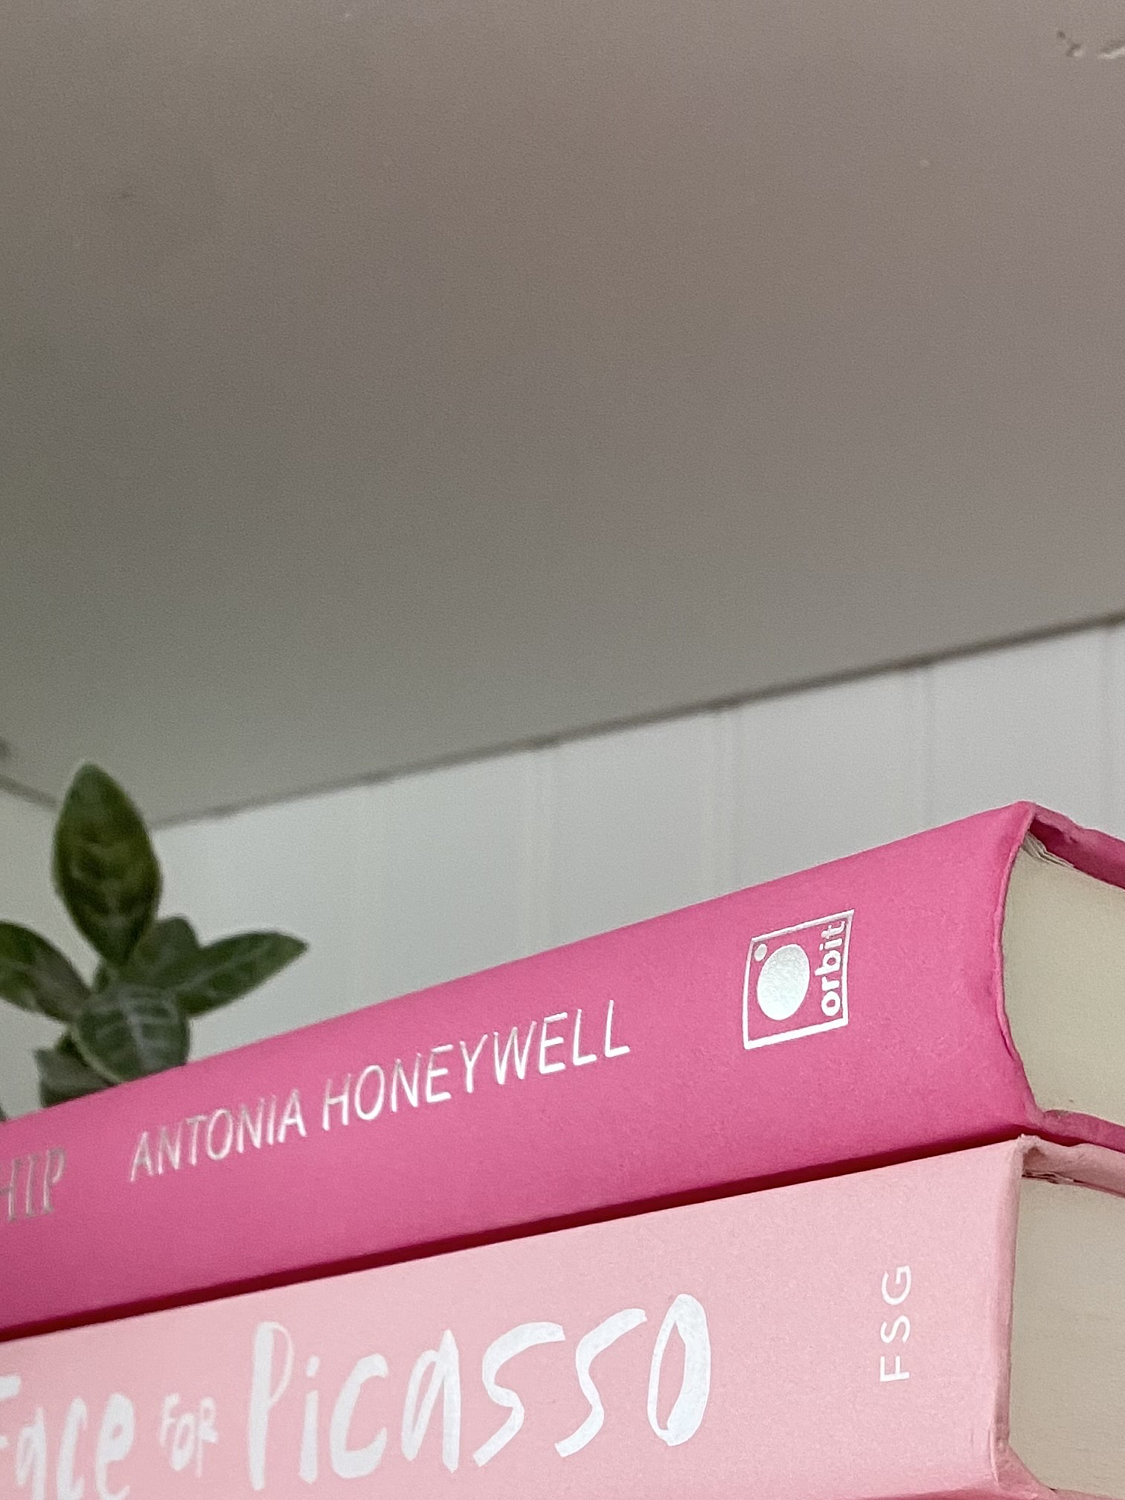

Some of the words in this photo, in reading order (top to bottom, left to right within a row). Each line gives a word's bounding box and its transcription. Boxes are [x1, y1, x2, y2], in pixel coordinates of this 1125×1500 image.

[814, 920, 846, 1017] orbit
[129, 1093, 306, 1182] ANTONIA
[322, 1000, 631, 1130] HONEYWELL
[247, 1293, 711, 1490] Picasso
[880, 1265, 912, 1383] FSG
